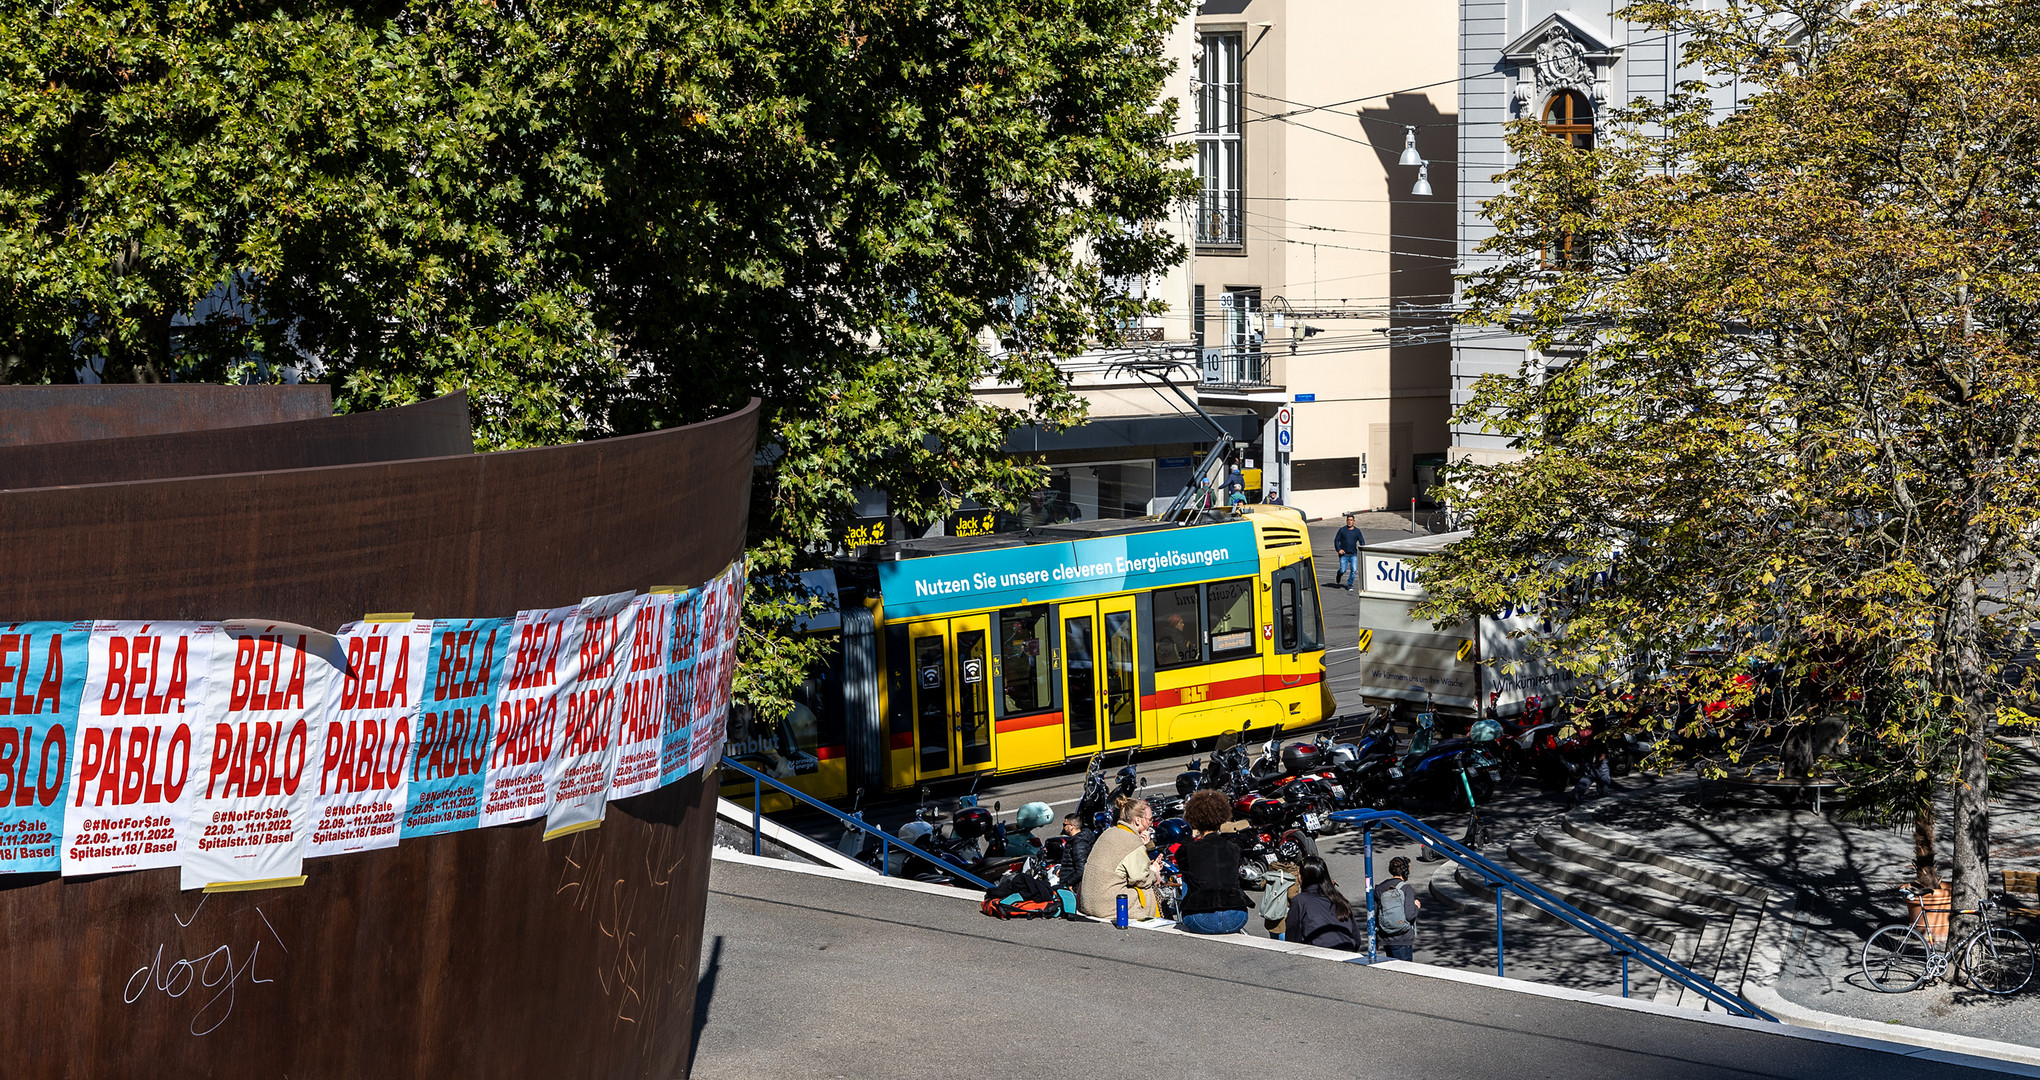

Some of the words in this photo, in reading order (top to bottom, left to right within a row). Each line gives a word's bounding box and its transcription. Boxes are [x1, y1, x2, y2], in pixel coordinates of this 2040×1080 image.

[1221, 296, 1232, 306] 30
[1207, 354, 1219, 371] 10
[955, 517, 978, 530] Jack
[915, 573, 970, 597] Nutzen
[973, 572, 997, 590] Sie
[1000, 569, 1049, 587] unsere
[1052, 562, 1113, 581] cleveren
[1116, 547, 1229, 573] Energielösungen
[434, 620, 497, 701] BÉLA
[509, 613, 564, 691] BÉLA
[100, 624, 188, 716] BÉLA
[228, 625, 307, 712] BÉLA
[340, 624, 410, 711] BÉLA
[1372, 669, 1382, 678] Wir
[1383, 671, 1409, 681] kümmern
[1429, 675, 1440, 685] Ihre
[1441, 677, 1464, 688] Wäsche
[1493, 678, 1512, 692] Wir
[1180, 685, 1209, 704] BLT
[491, 693, 557, 770] PABLO
[413, 704, 491, 782] PABLO
[205, 718, 307, 800] PABLO
[320, 716, 410, 795] PABLO
[75, 723, 192, 808] PABLO
[489, 790, 510, 802] 22.09.
[515, 783, 545, 798] 11.11.2022
[528, 794, 547, 808] Basel
[412, 803, 435, 815] 22.09.
[441, 796, 477, 811] 11.11.2022
[456, 807, 478, 821] Basel
[204, 825, 236, 837] 22.09.
[245, 819, 292, 833] 11.11.2022
[318, 819, 346, 831] 22.09.
[353, 812, 396, 827] 11.11.2022
[370, 824, 396, 838] Basel
[75, 833, 111, 846] 22.09.
[121, 828, 175, 842] 11.11.2022
[265, 831, 294, 844] Basel
[20, 845, 56, 859] Basel
[144, 841, 178, 854] Basel
